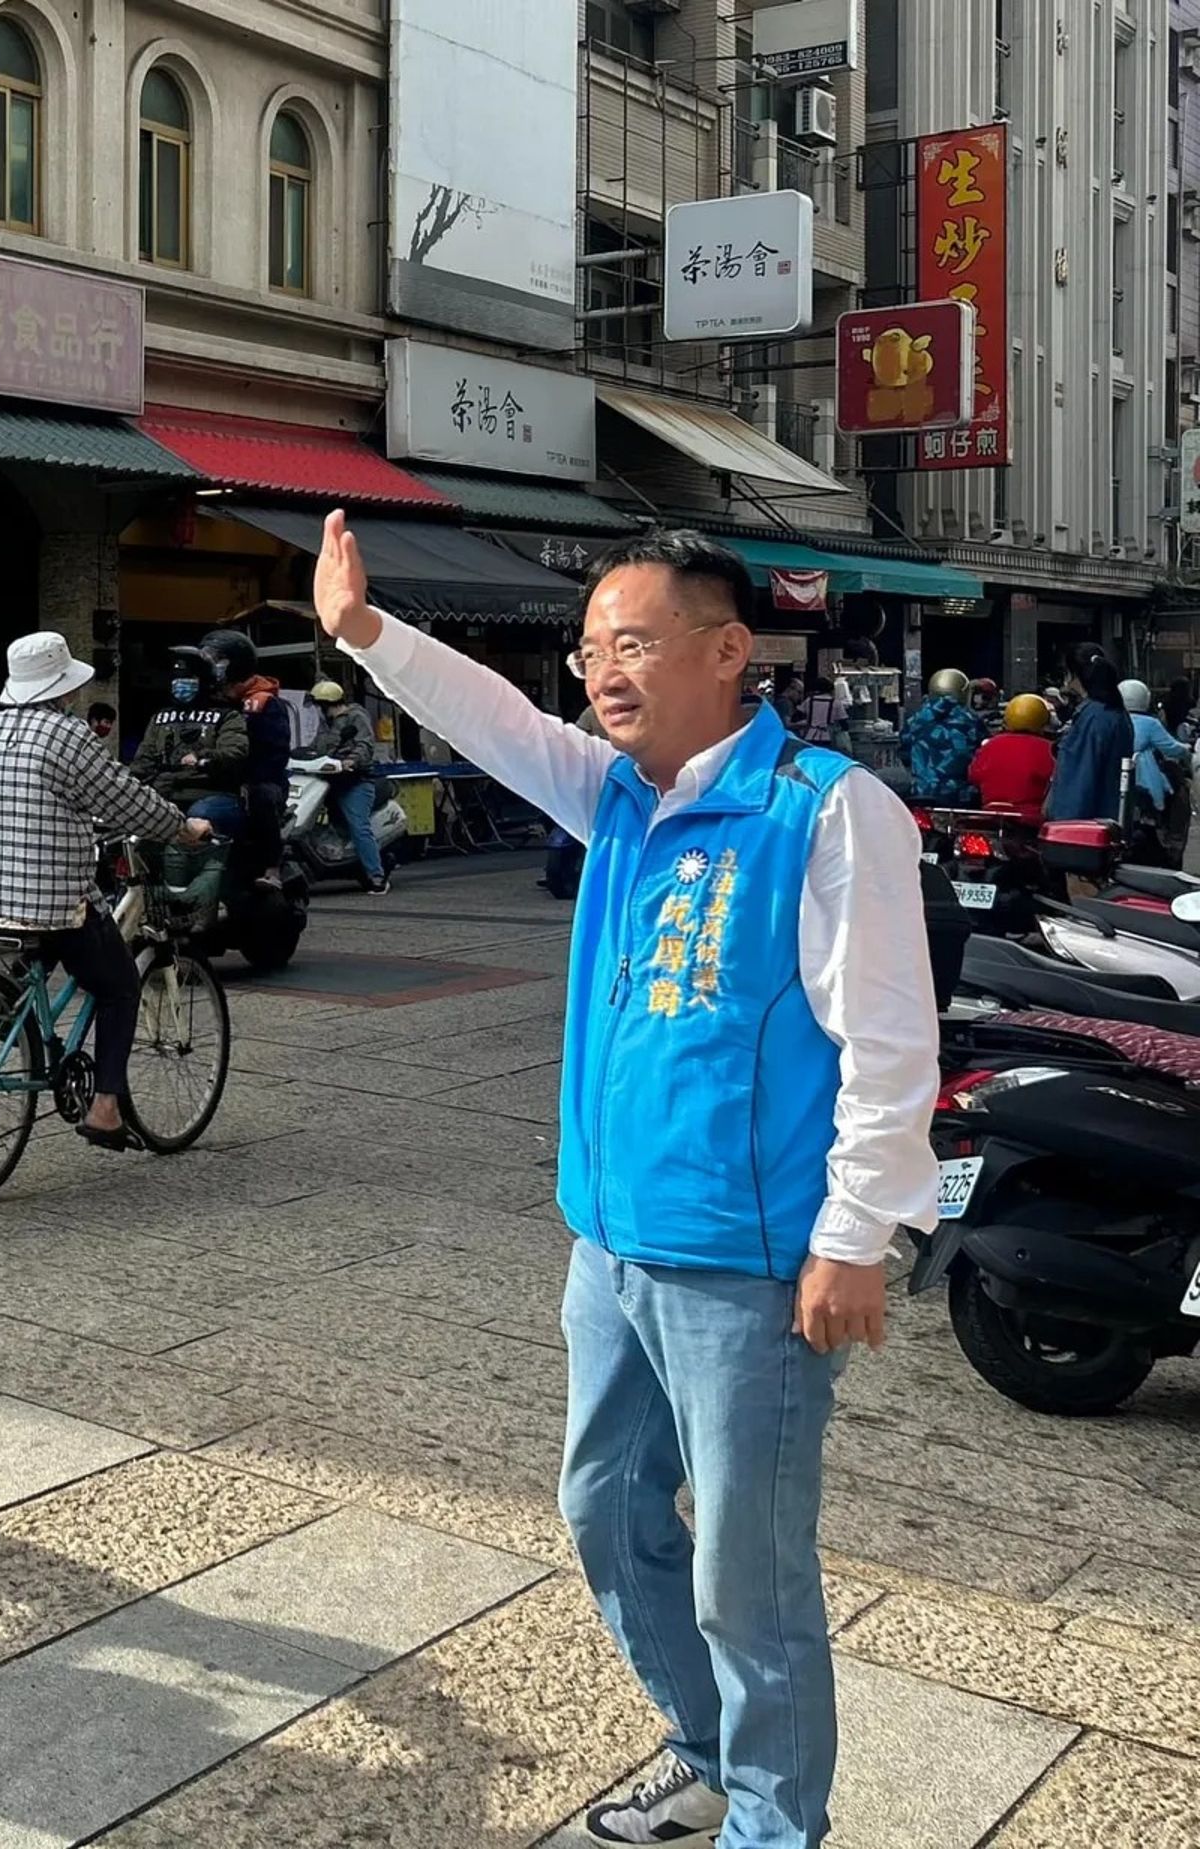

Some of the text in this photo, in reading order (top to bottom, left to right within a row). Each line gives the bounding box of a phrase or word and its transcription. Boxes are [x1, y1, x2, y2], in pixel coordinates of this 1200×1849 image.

[681, 241, 779, 285] 茶湯會
[451, 378, 524, 442] 茶湯會
[924, 427, 999, 459] 蚵仔煎
[540, 538, 588, 569] 茶湯會
